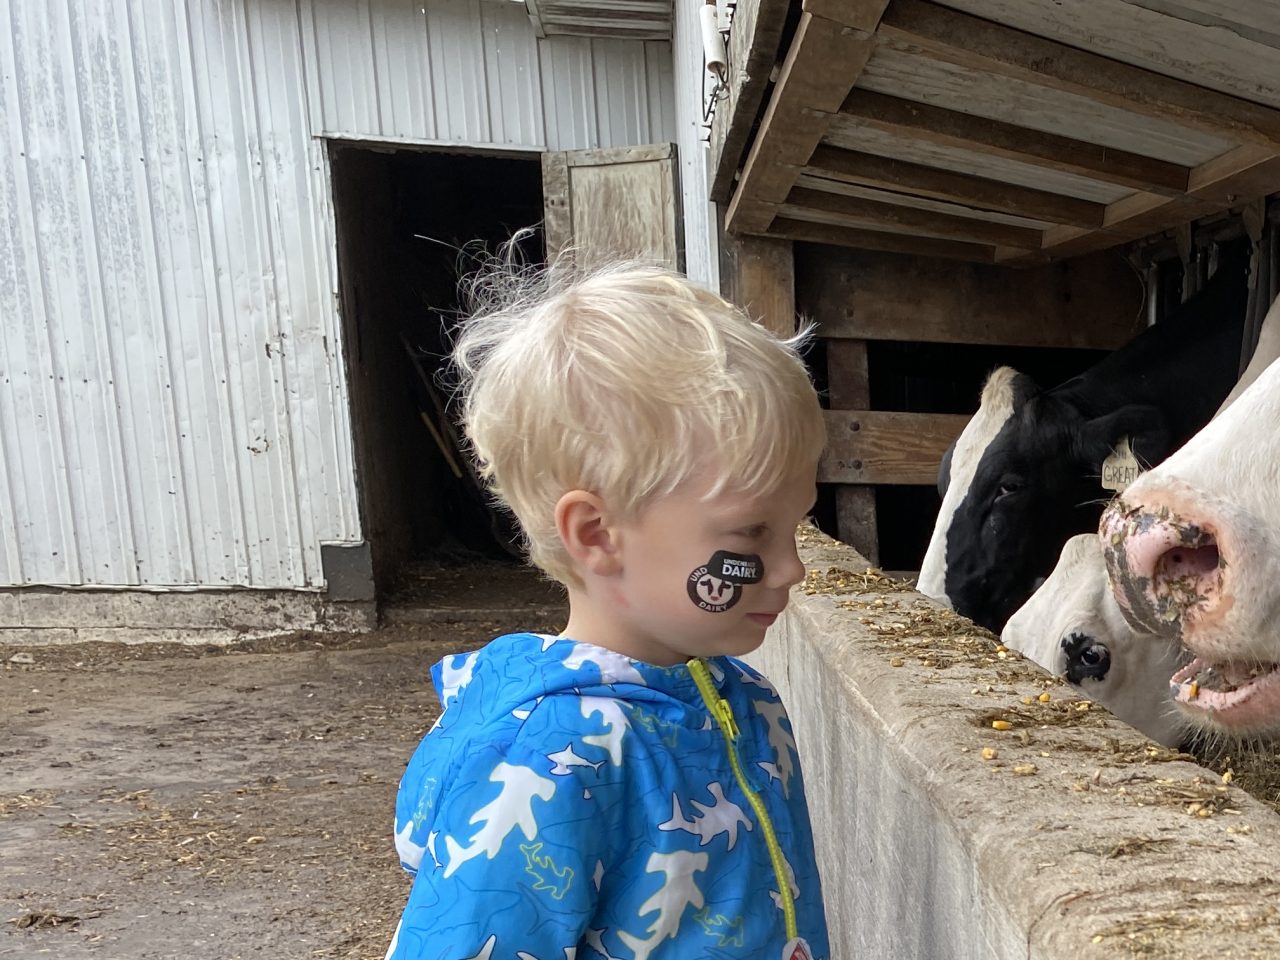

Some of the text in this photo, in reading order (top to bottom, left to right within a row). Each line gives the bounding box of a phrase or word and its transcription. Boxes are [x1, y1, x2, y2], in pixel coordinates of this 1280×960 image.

[1104, 465, 1136, 484] GREAT
[690, 567, 708, 582] UND
[722, 564, 757, 578] DAIRY
[698, 601, 727, 612] DAIRY
